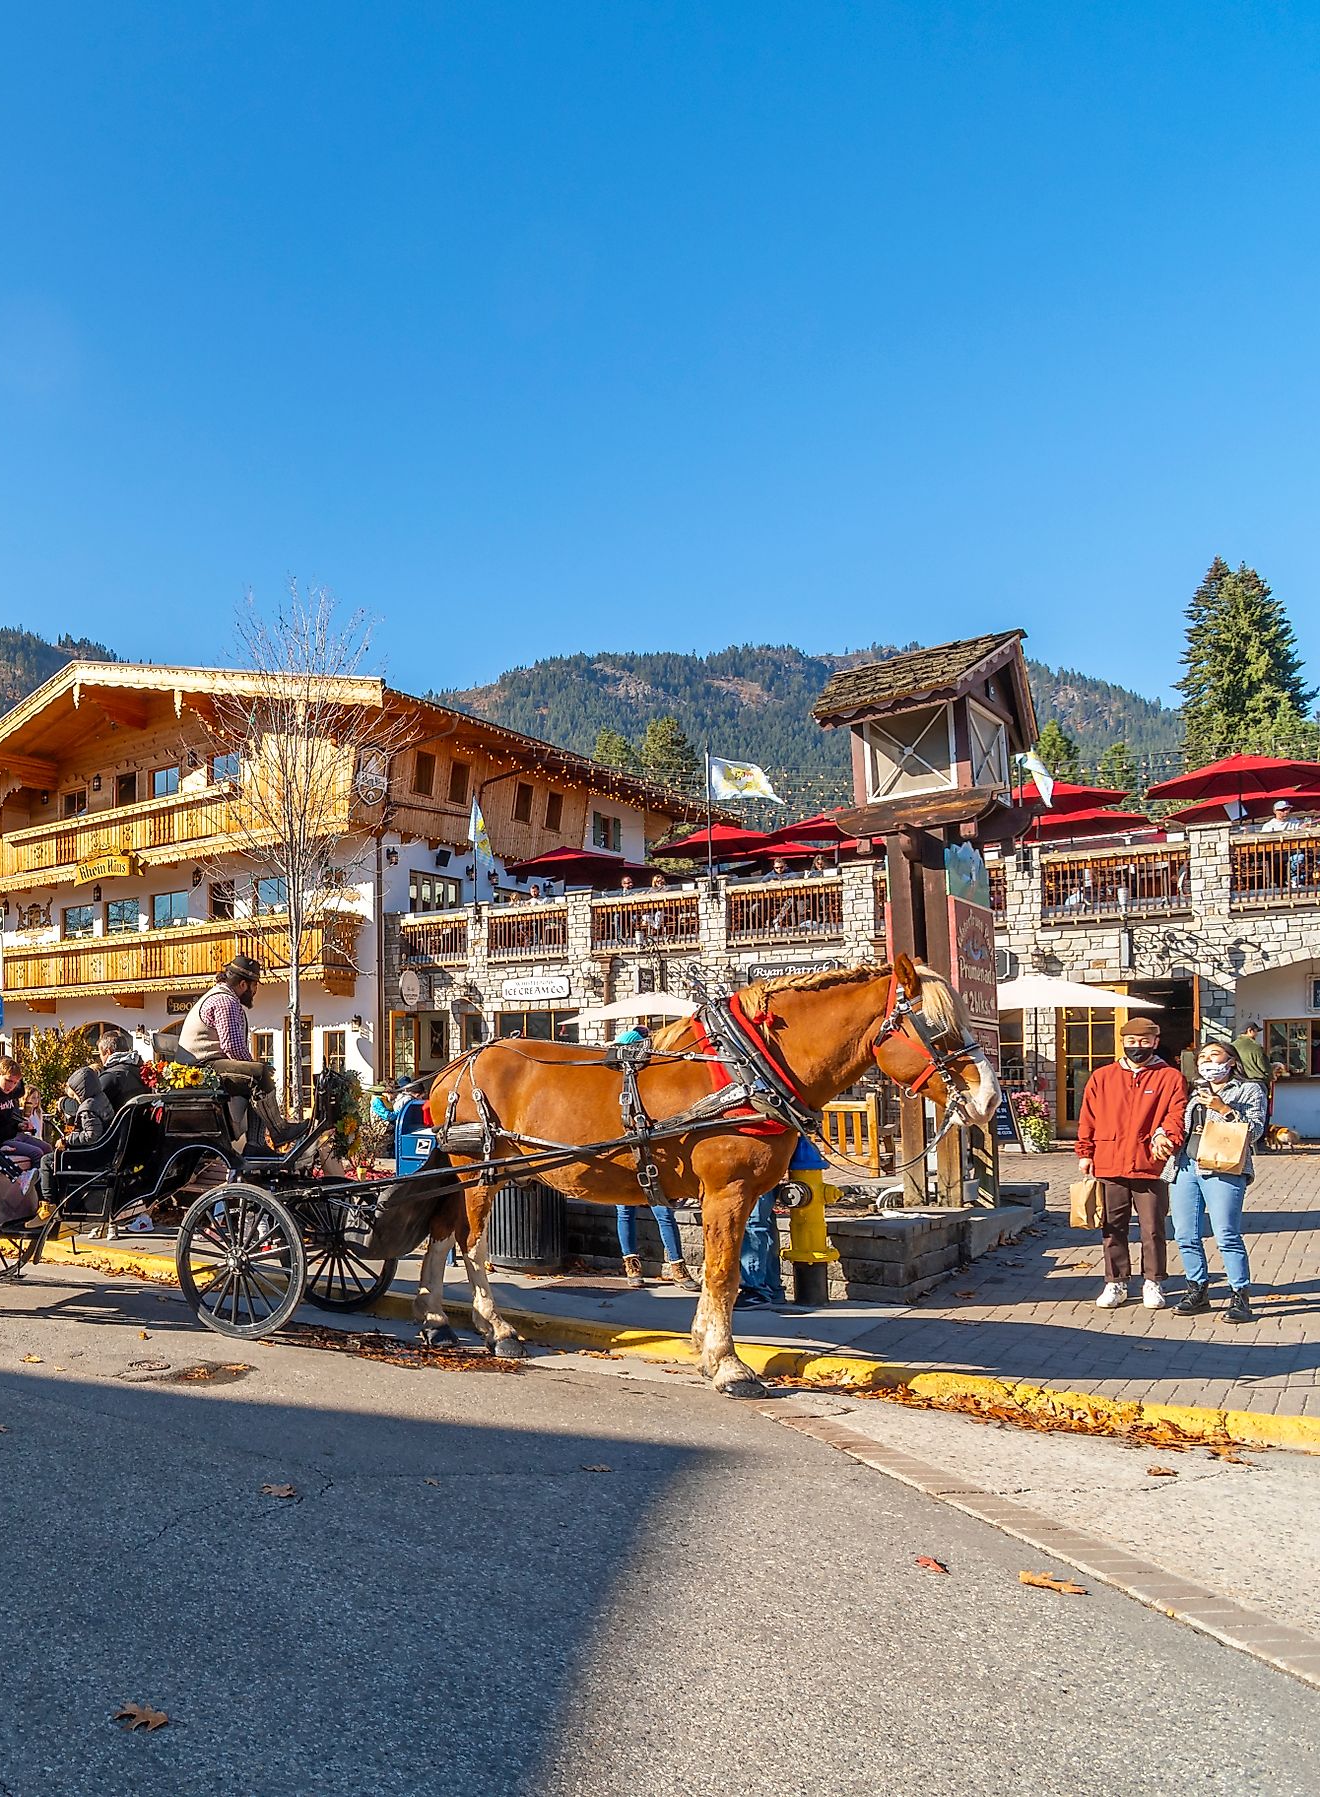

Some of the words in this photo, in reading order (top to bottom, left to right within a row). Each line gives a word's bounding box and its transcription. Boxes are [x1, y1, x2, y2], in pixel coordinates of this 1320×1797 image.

[79, 863, 106, 880] Rhein
[753, 967, 784, 981] Ryan
[784, 961, 831, 976] Patrick
[959, 956, 996, 985] Promenade
[505, 988, 517, 996] ICE
[518, 986, 549, 996] CREAM
[173, 1001, 196, 1012] BOO
